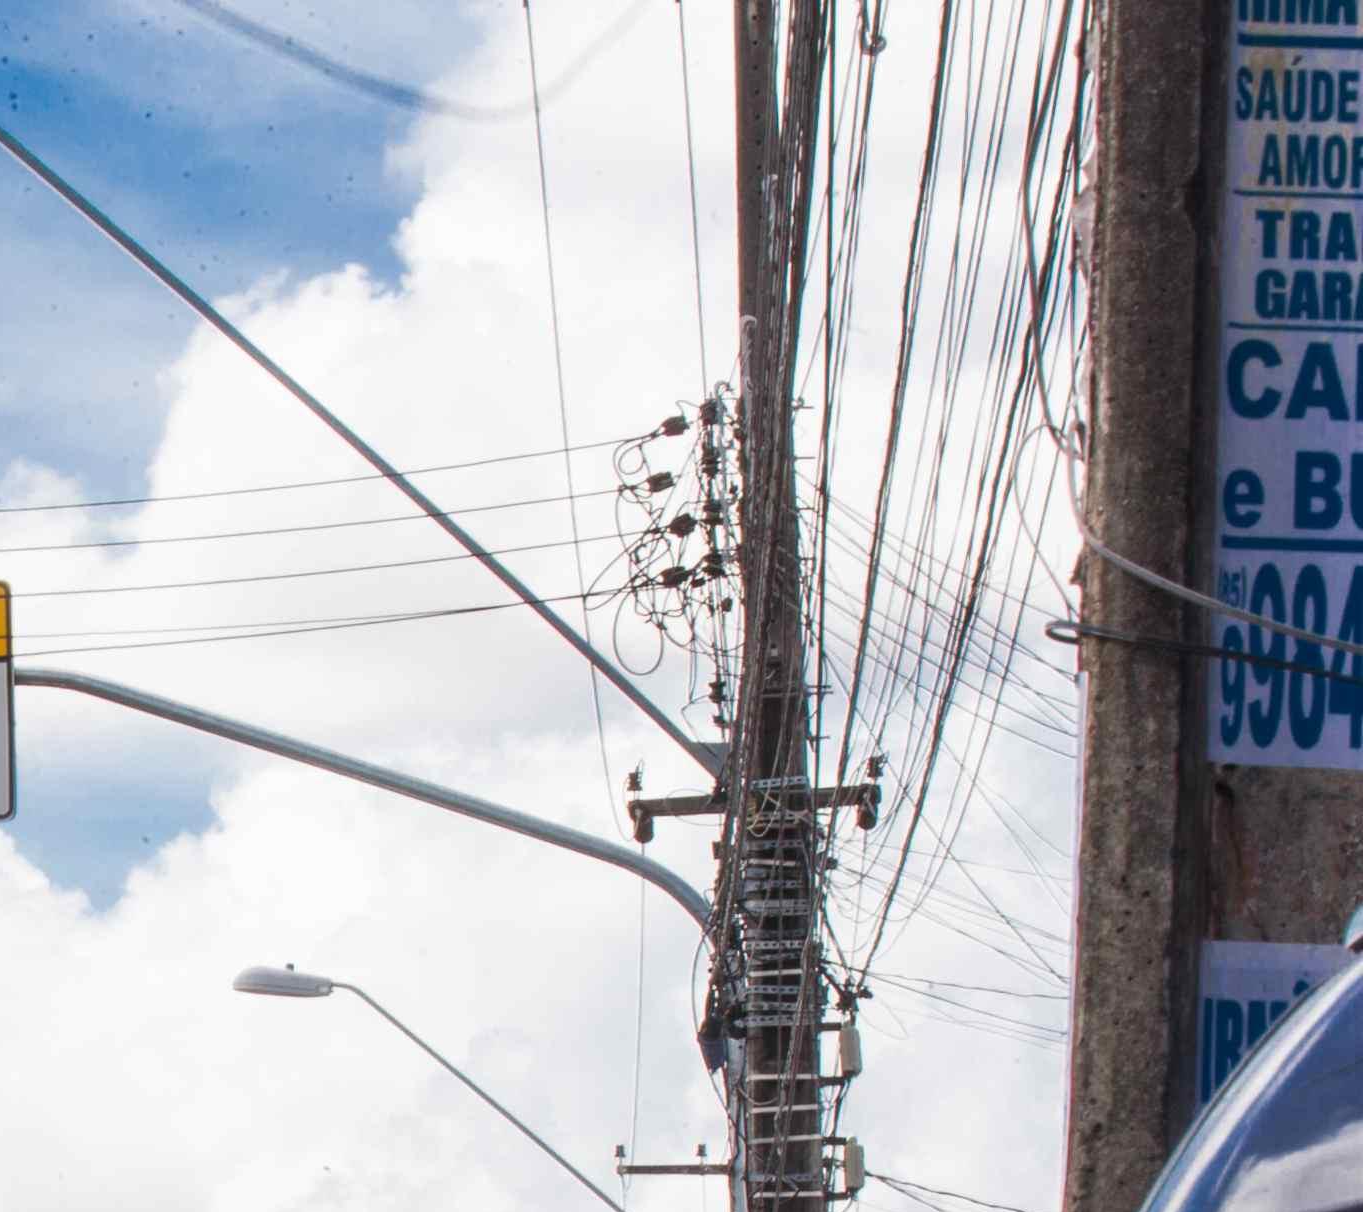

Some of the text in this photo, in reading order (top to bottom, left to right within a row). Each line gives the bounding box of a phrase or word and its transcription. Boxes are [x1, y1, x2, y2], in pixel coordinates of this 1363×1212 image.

[1235, 56, 1359, 123] SAÚDE
[1255, 269, 1363, 321] GAR
[1227, 339, 1363, 421] CA
[1223, 469, 1265, 528] e
